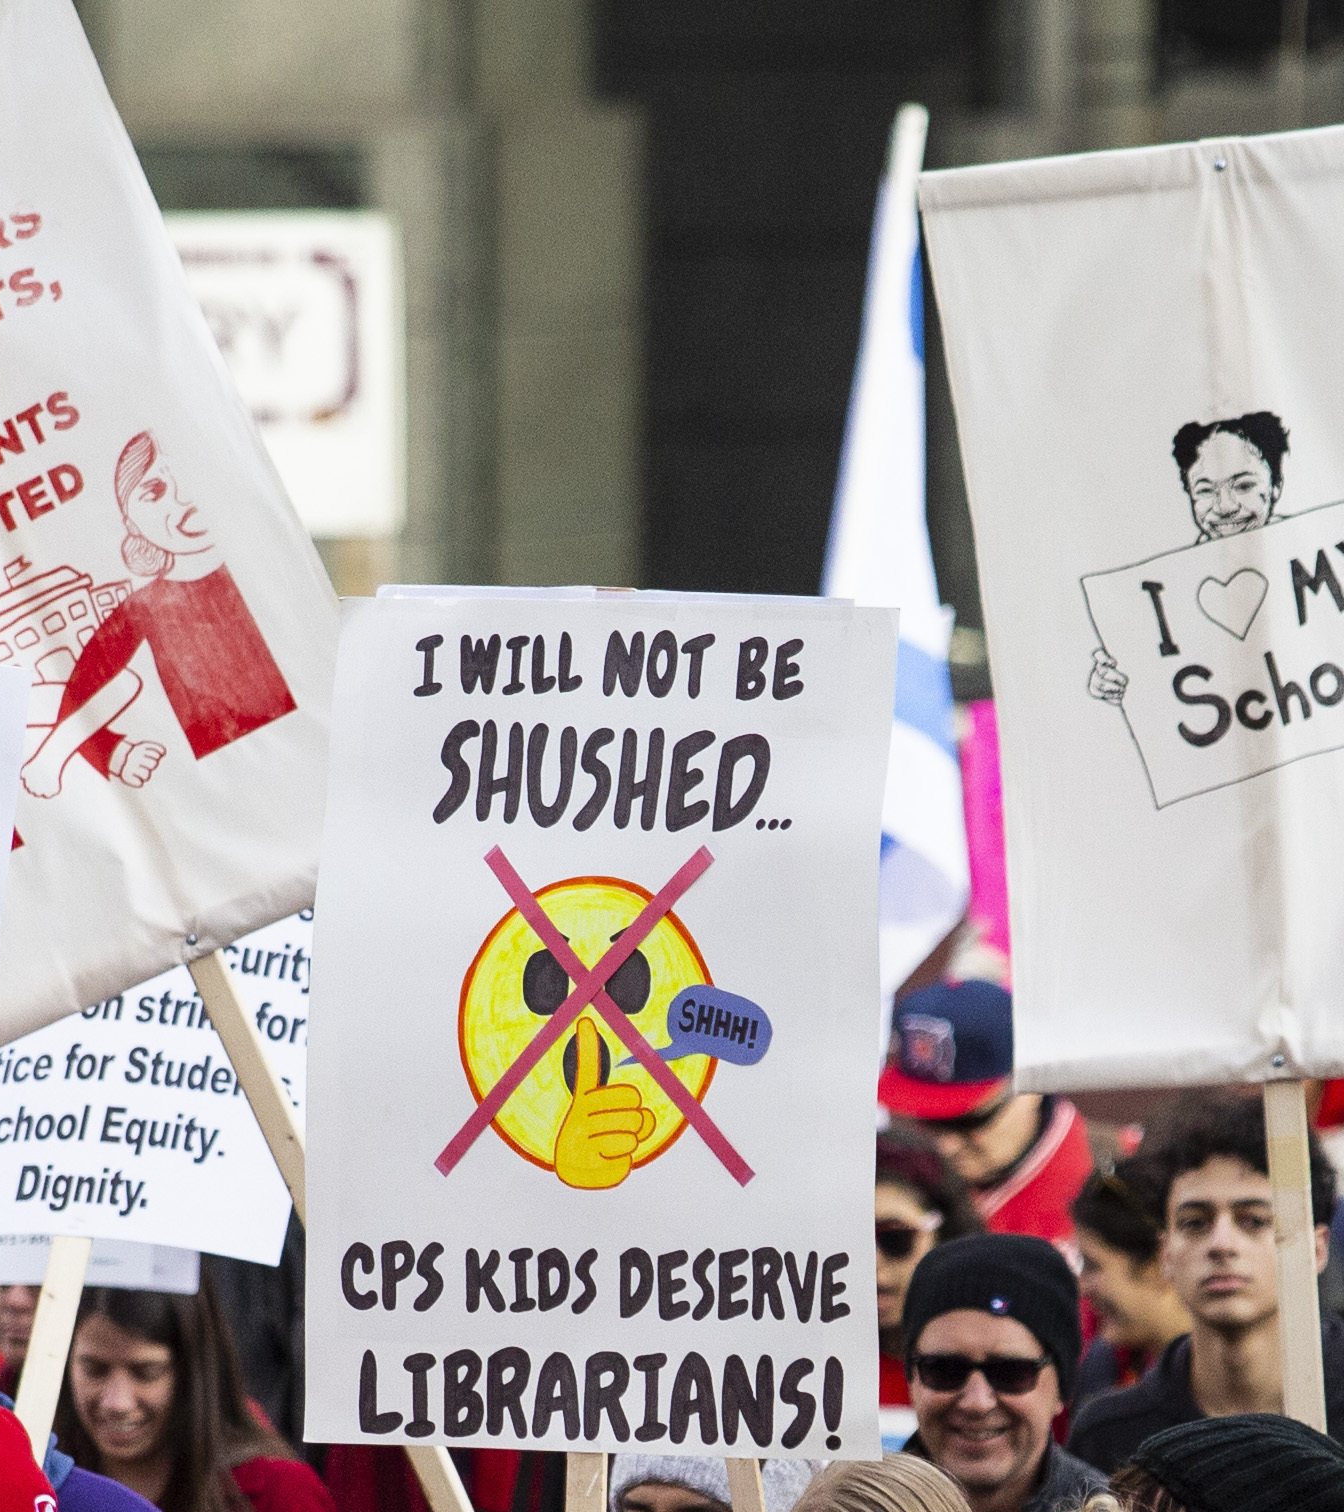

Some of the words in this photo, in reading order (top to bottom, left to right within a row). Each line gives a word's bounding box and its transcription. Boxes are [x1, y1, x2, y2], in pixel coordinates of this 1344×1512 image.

[1141, 580, 1180, 657] I
[413, 634, 443, 697] I
[460, 631, 583, 695] WILL
[603, 629, 716, 699] NOT
[736, 636, 804, 701] BE
[432, 719, 792, 832] SHUSHED...
[678, 999, 758, 1050] SHHH!
[64, 1043, 116, 1080] for
[100, 1106, 226, 1164] Equity.
[16, 1165, 148, 1217] Dignity.
[340, 1240, 445, 1312] CPS
[465, 1247, 598, 1314] KIDS
[619, 1246, 851, 1323] DESERVE
[359, 1346, 844, 1451] LIBRARIANS!
